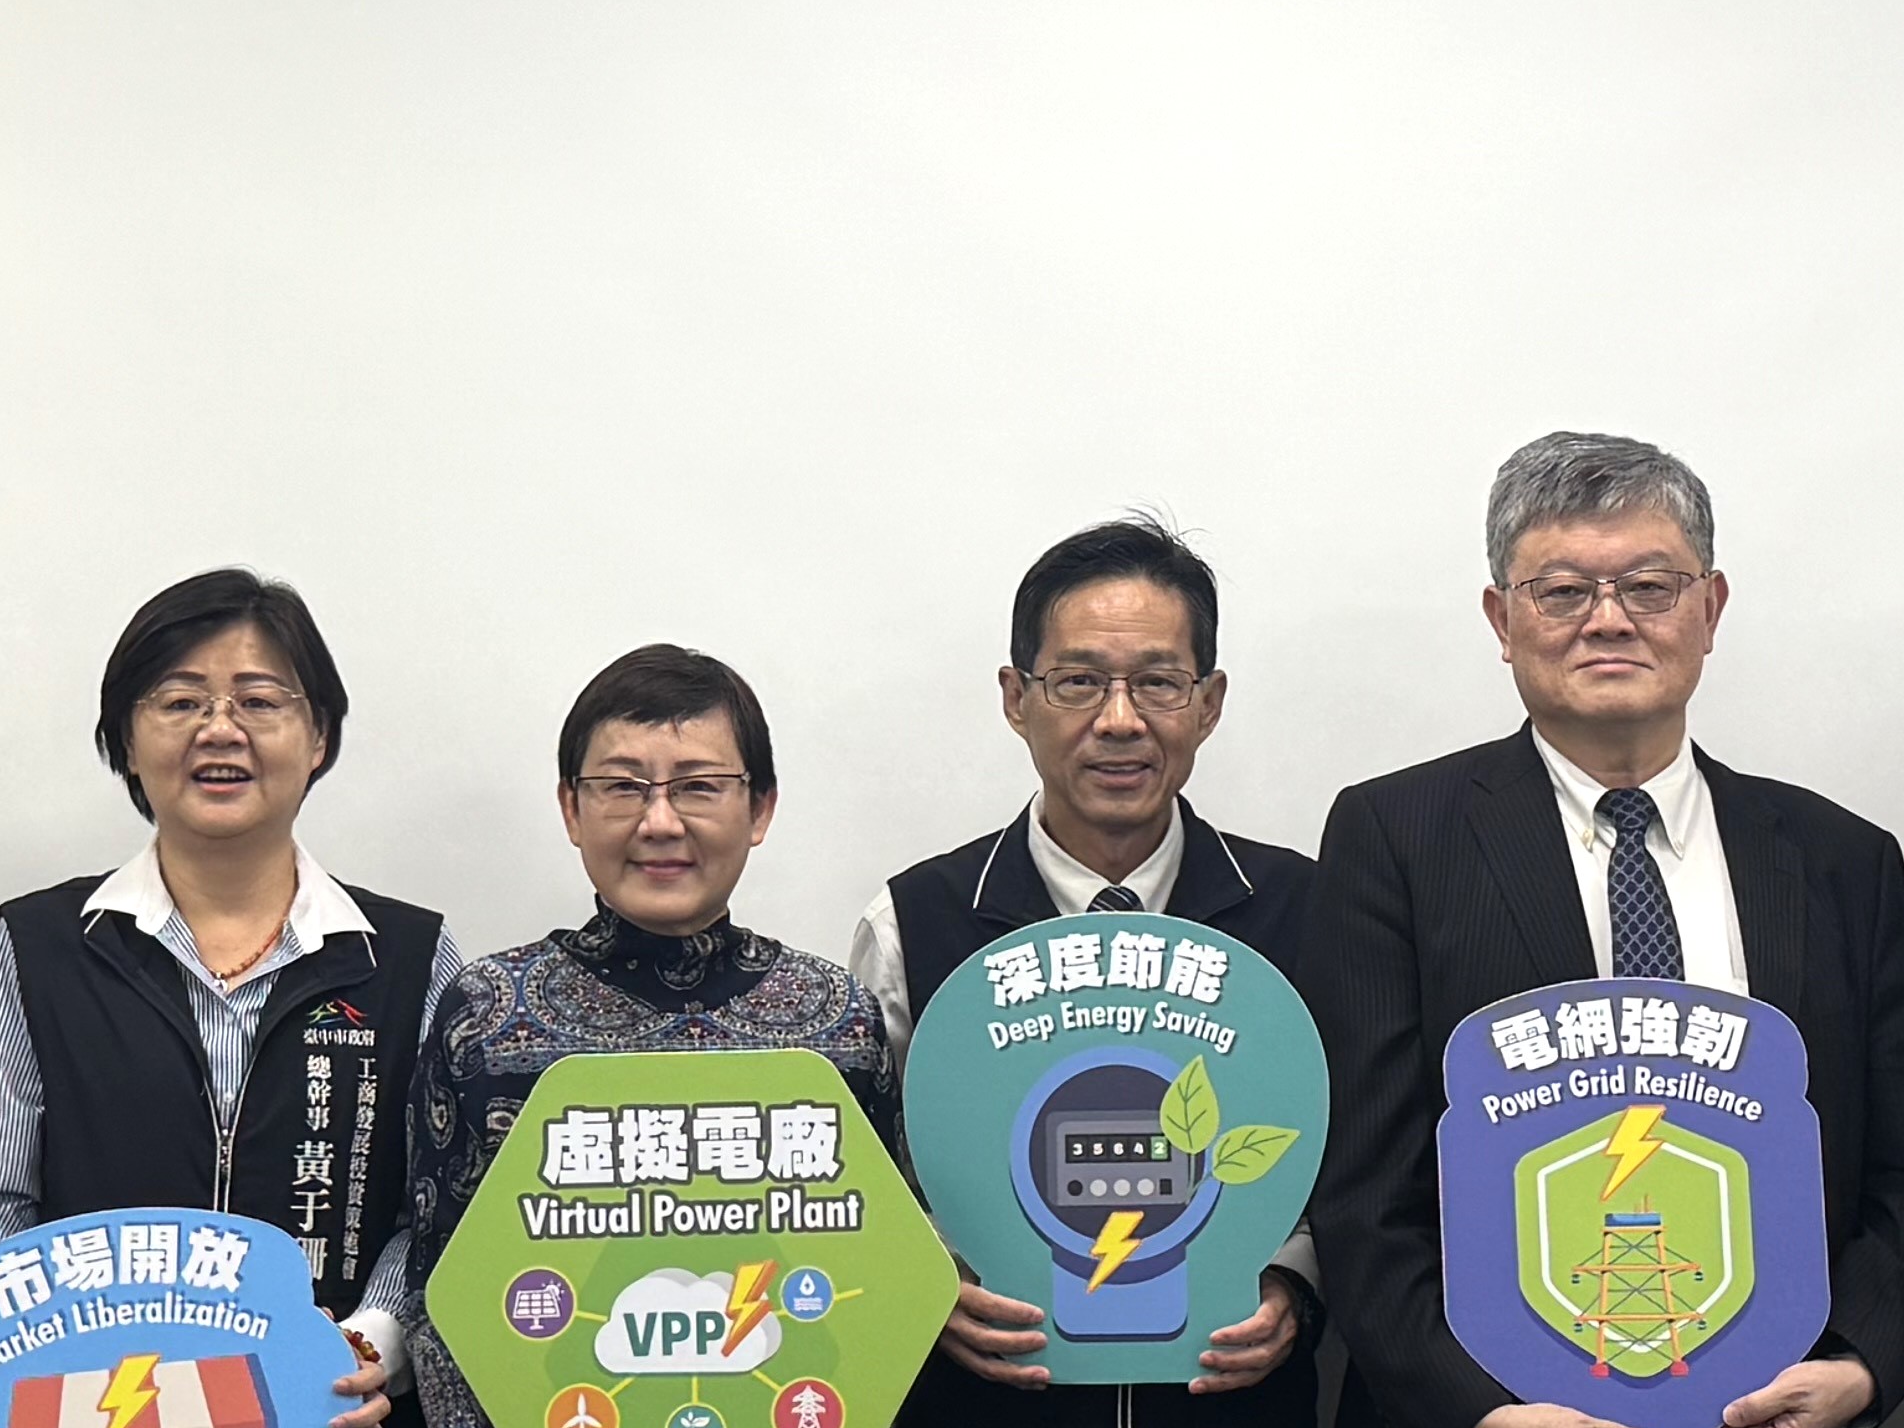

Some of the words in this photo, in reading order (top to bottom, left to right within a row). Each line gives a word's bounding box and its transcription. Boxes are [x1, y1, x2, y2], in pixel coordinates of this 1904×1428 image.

[983, 931, 1228, 1007] 深度節能
[987, 1013, 1054, 1049] Deep
[1060, 1001, 1146, 1033] Energy
[1153, 1001, 1236, 1054] Saving
[1491, 997, 1748, 1071] 電網強韌
[306, 1054, 331, 1131] 總幹事
[1482, 1081, 1562, 1123] Power
[1569, 1065, 1626, 1097] Grid
[1634, 1066, 1763, 1121] Resilience
[542, 1104, 840, 1185] 虛擬電廠
[522, 1192, 641, 1236] Virtual
[653, 1195, 759, 1233] Power
[770, 1188, 860, 1229] Plant
[72, 1293, 270, 1341] Liberalization
[623, 1311, 726, 1357] VPP
